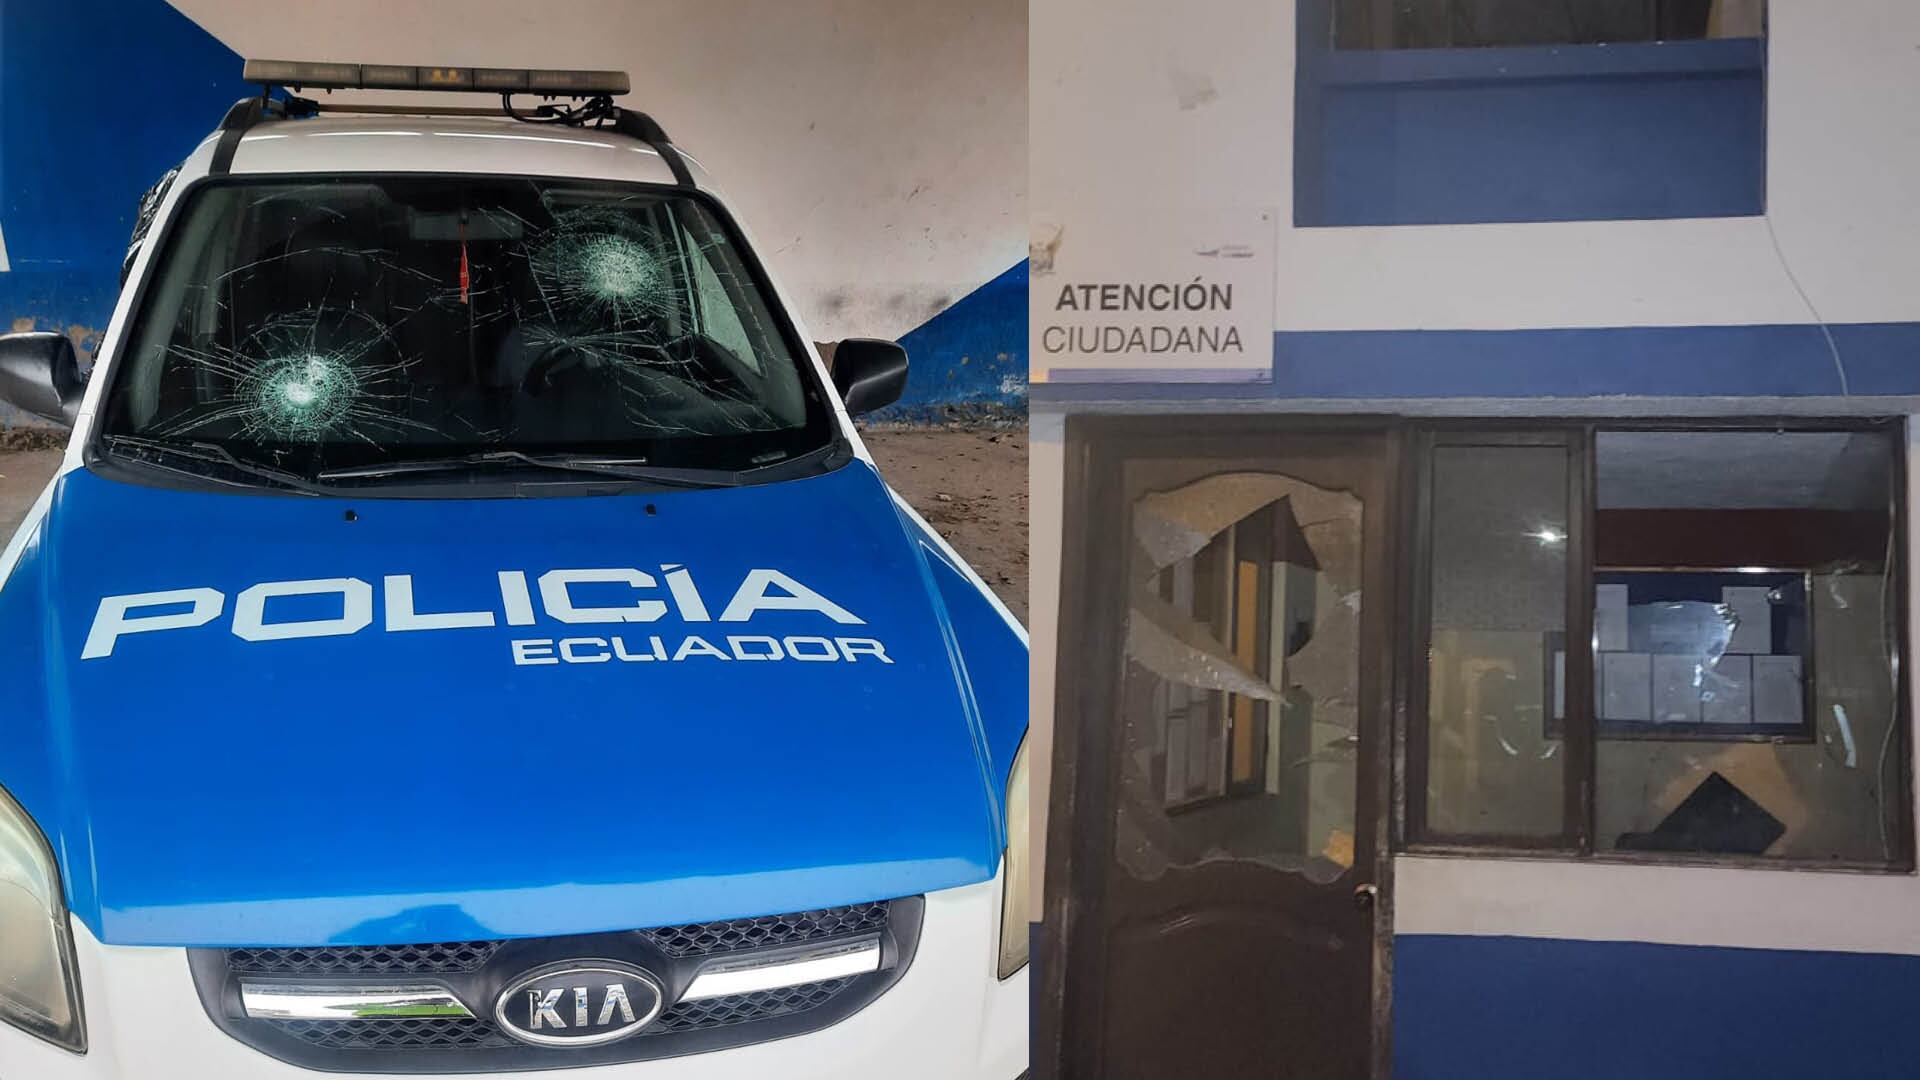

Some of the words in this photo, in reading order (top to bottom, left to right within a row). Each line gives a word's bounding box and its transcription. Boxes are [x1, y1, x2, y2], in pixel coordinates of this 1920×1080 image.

[1055, 275, 1233, 312] ATENCIÓN
[1042, 325, 1244, 354] CIUDADANA
[80, 563, 868, 660] POLICÍA
[511, 636, 895, 665] ECUADOR
[527, 983, 636, 1030] KIA
